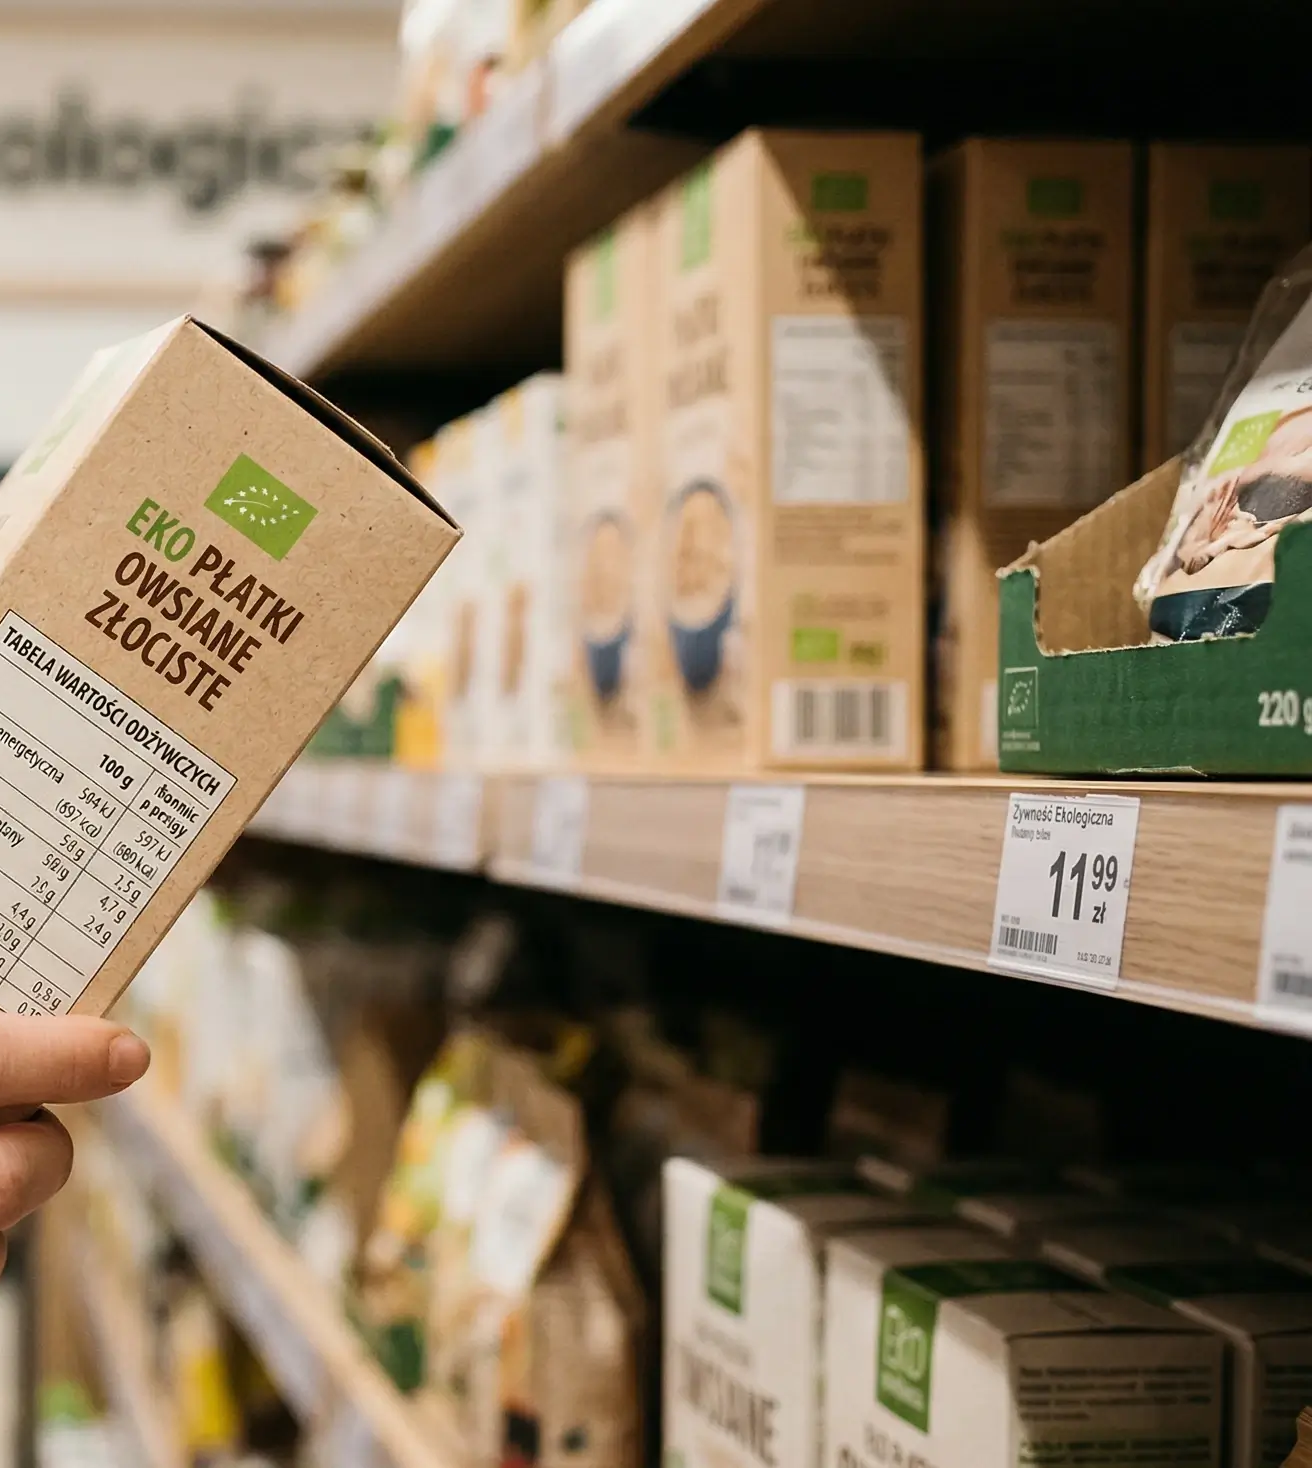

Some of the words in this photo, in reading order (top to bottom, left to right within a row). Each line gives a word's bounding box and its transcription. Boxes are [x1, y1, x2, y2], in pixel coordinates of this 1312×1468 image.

[125, 497, 196, 563] EKO
[188, 544, 305, 645] PŁATKI
[114, 551, 262, 674] OWSIANE
[84, 589, 232, 712] ZŁOCISTE
[3, 626, 56, 676] TABELA
[55, 665, 128, 727] WARTOŚCI
[125, 719, 220, 796] ODŻYWCZYCH
[1258, 689, 1299, 727] 220
[99, 754, 124, 778] 100
[119, 776, 134, 790] g
[44, 890, 55, 903] g
[100, 896, 119, 912] 4,7
[114, 910, 126, 924] g
[129, 890, 141, 903] g
[1091, 902, 1106, 924] zł
[9, 938, 20, 951] g
[83, 915, 104, 934] 2,4
[100, 931, 111, 944] g
